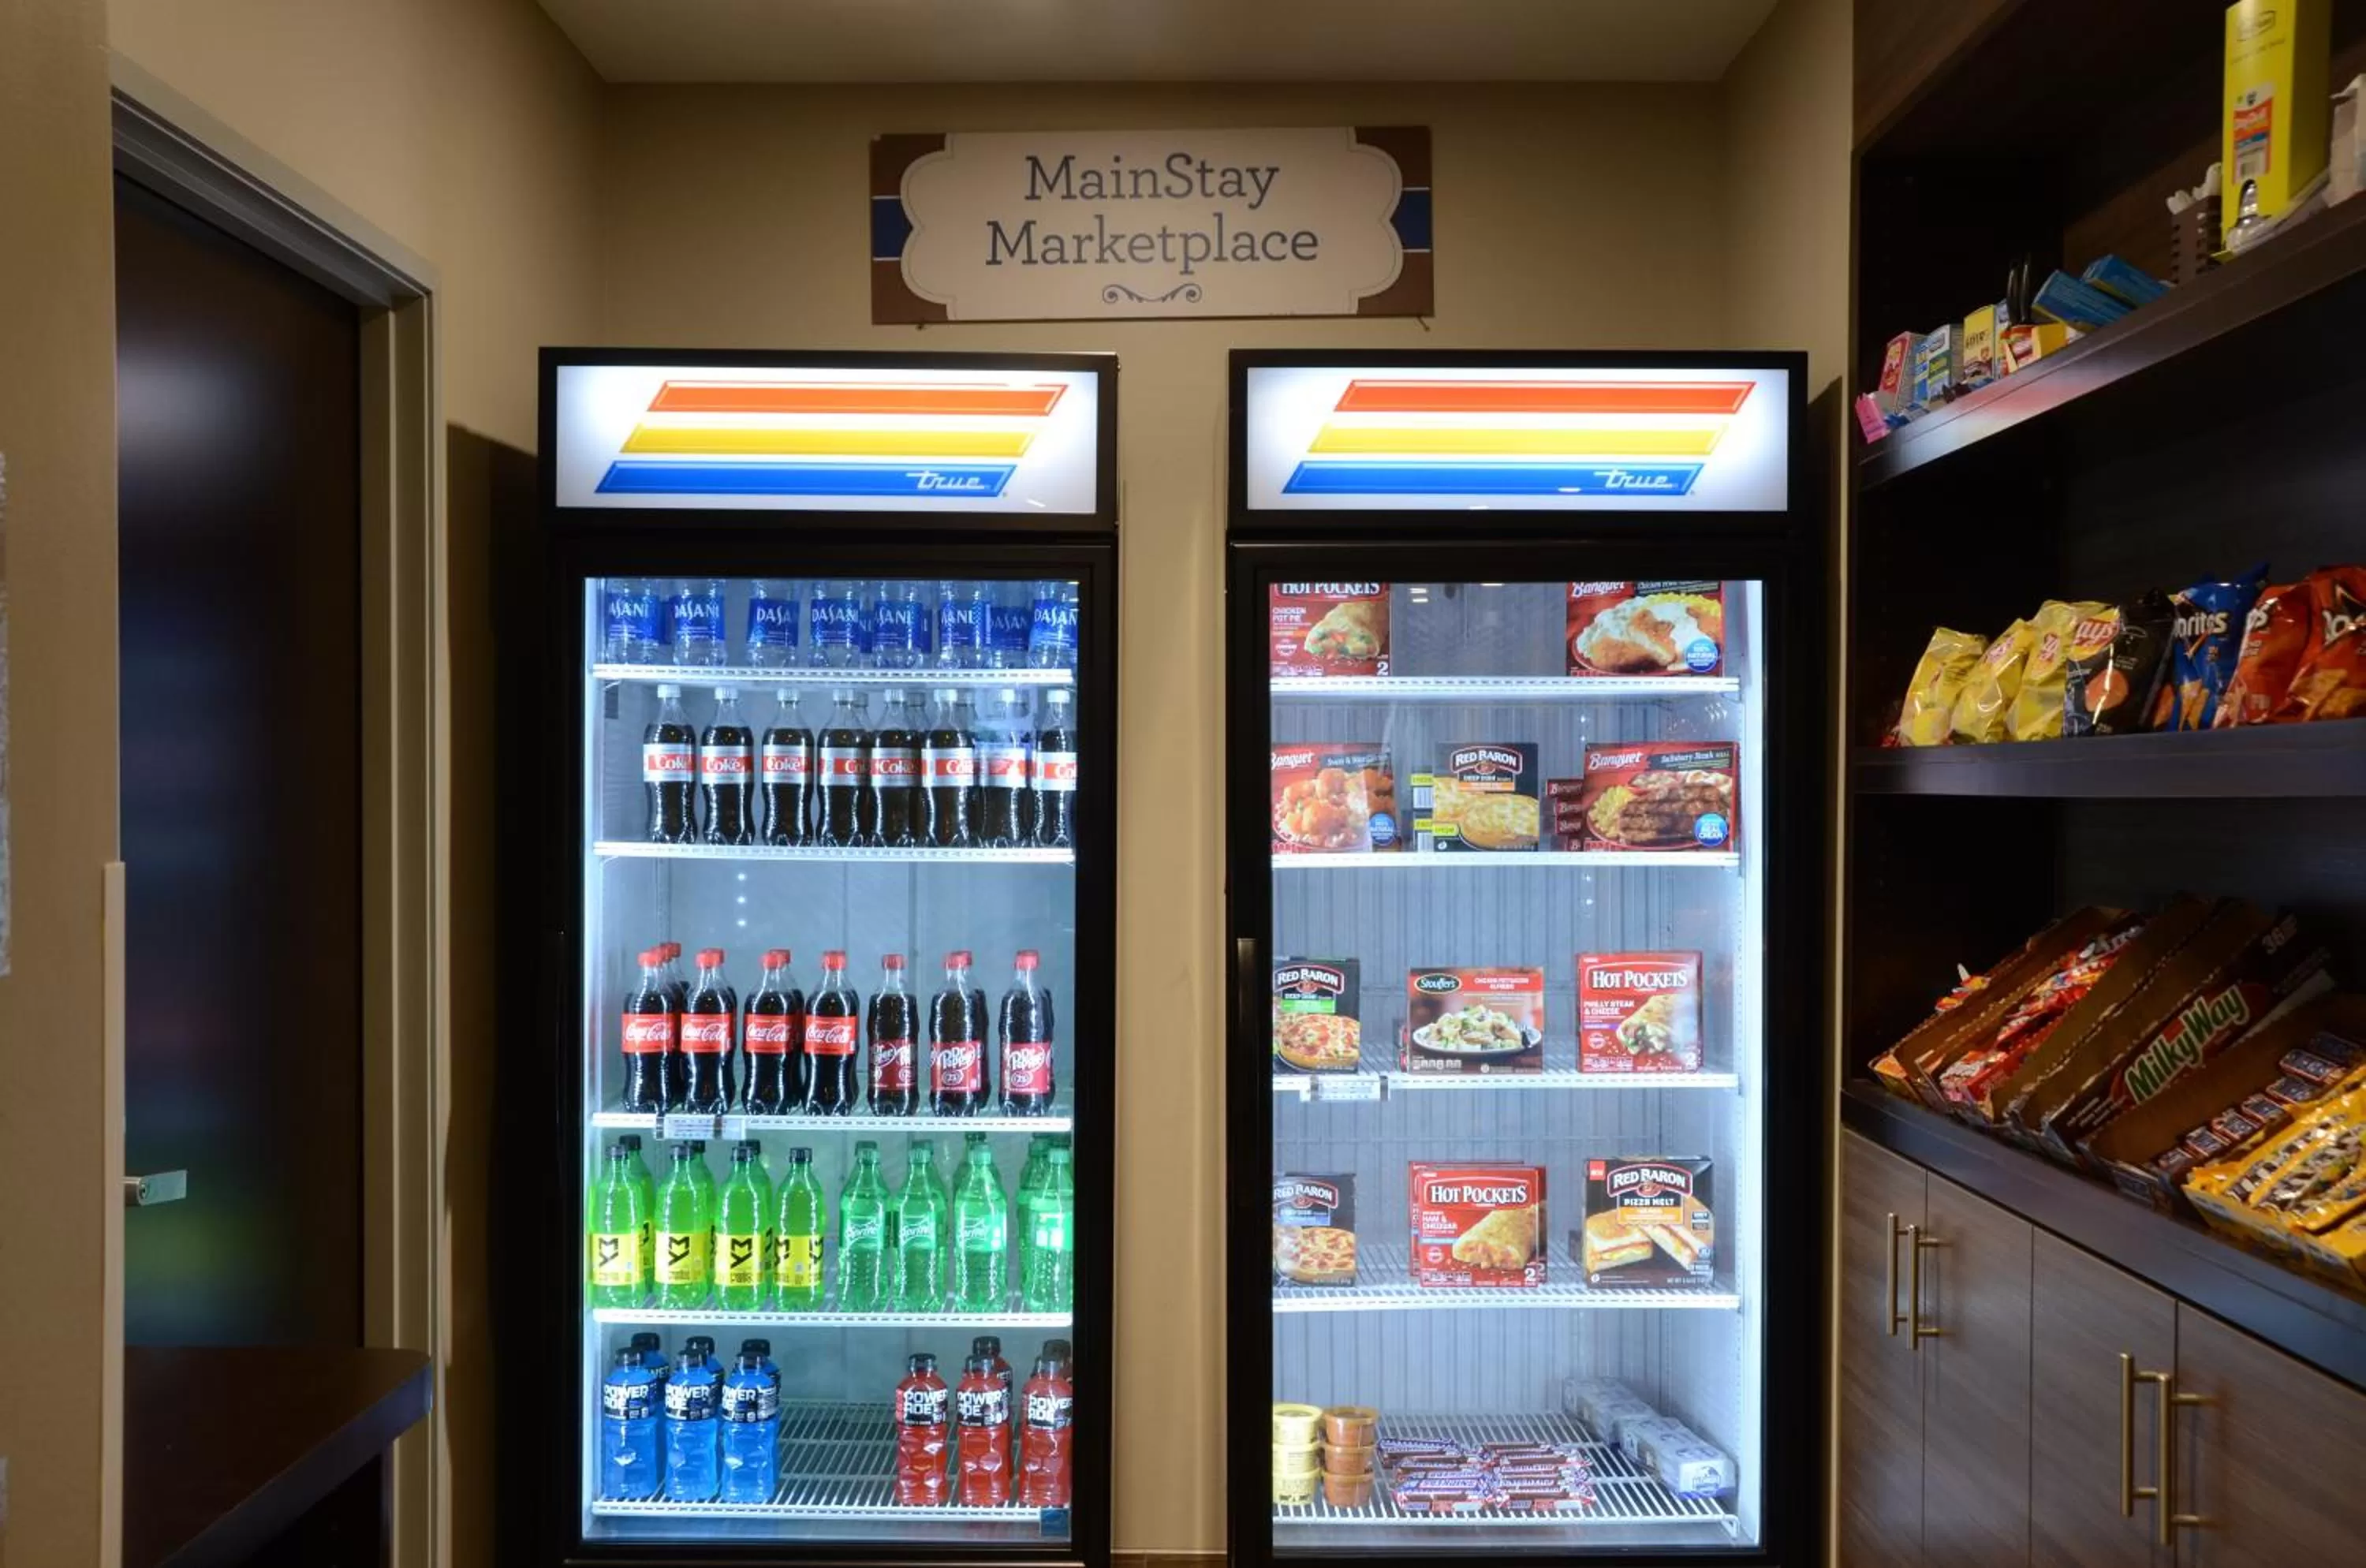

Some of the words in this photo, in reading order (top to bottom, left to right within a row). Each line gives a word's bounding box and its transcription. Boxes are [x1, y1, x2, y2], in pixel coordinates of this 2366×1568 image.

[1024, 152, 1281, 210] MainStay
[985, 213, 1320, 275] Marketplace
[1376, 661, 1389, 676] 2
[766, 755, 800, 771] Coke
[1455, 752, 1477, 767] RED
[1479, 749, 1517, 767] BARON
[1588, 751, 1643, 771] Banquet
[1278, 971, 1299, 985] RED
[1301, 968, 1338, 987] BARON
[1592, 971, 1622, 988] HOT
[1624, 970, 1689, 989] POCKETS
[2124, 1033, 2202, 1104] Milky
[2181, 984, 2250, 1047] Way
[1613, 1170, 1640, 1189] RED
[1640, 1168, 1685, 1187] BARON
[1296, 1184, 1333, 1201] BARON
[1430, 1185, 1461, 1203] HOT
[1463, 1185, 1528, 1204] POCKETS
[1524, 1267, 1536, 1282] 2
[957, 1391, 1003, 1406] POWER
[1028, 1394, 1072, 1413] POWE
